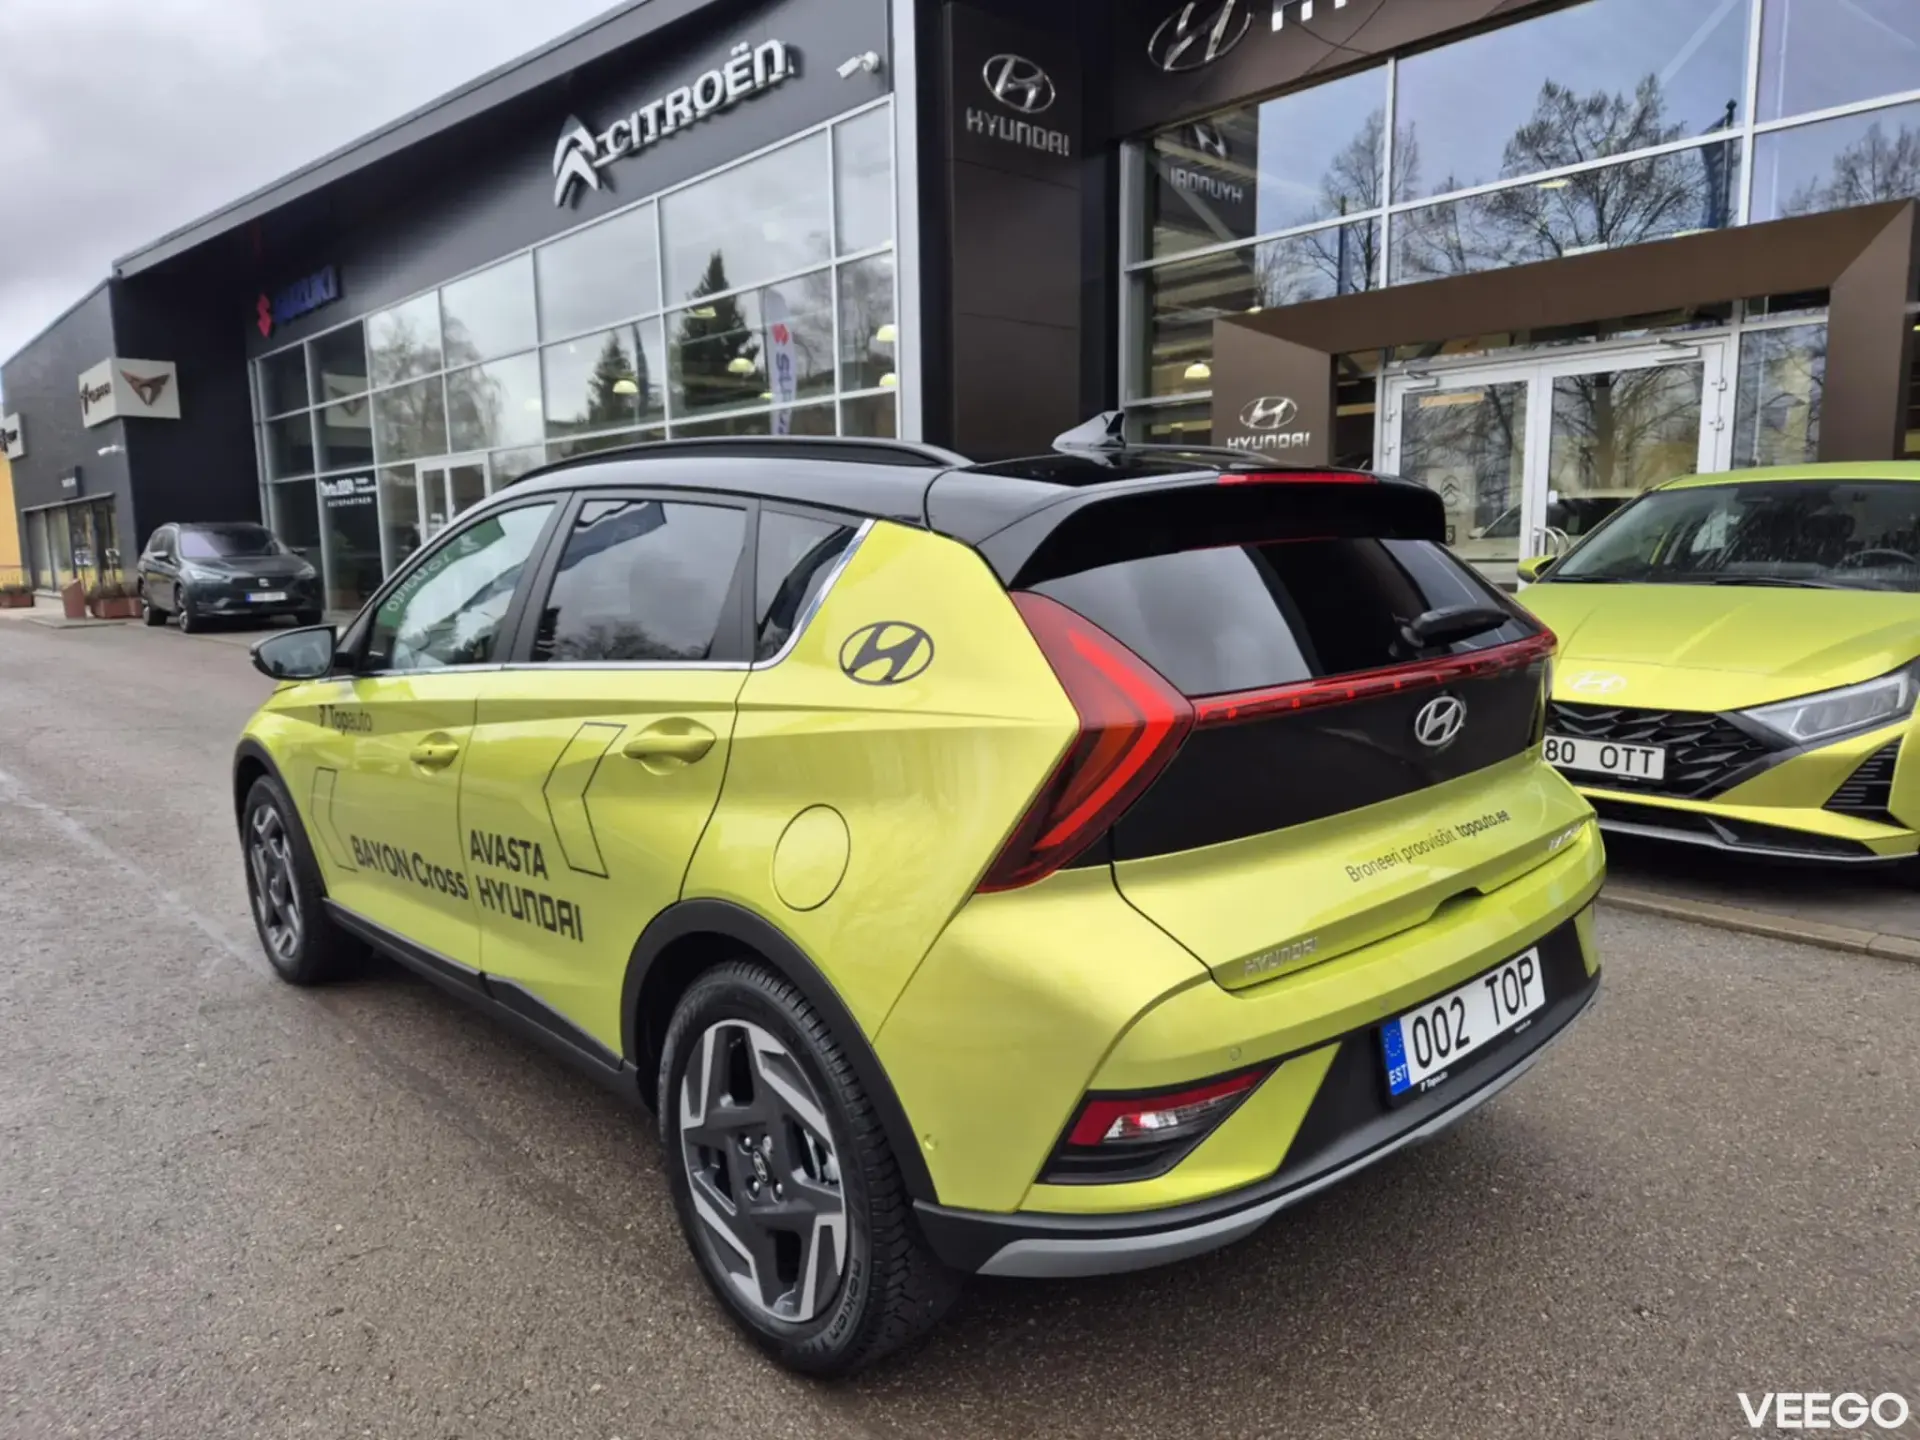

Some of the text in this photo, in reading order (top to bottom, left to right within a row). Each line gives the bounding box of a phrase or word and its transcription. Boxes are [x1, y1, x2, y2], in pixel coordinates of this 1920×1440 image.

[605, 39, 787, 153] CITROËN
[966, 107, 1069, 156] HYUNDAI
[1227, 432, 1310, 450] HYUNDAI
[328, 704, 373, 736] Topauto
[1600, 745, 1655, 774] OTT
[350, 834, 470, 900] BAYON Cross
[469, 829, 549, 881] AVASTA
[1344, 847, 1402, 882] Broneeri
[1455, 809, 1511, 838] topauto.ee
[475, 875, 584, 942] HYUNDAI
[1244, 936, 1318, 977] HYUNDAI
[1412, 956, 1534, 1069] 002 TOP
[1388, 1063, 1409, 1086] EST
